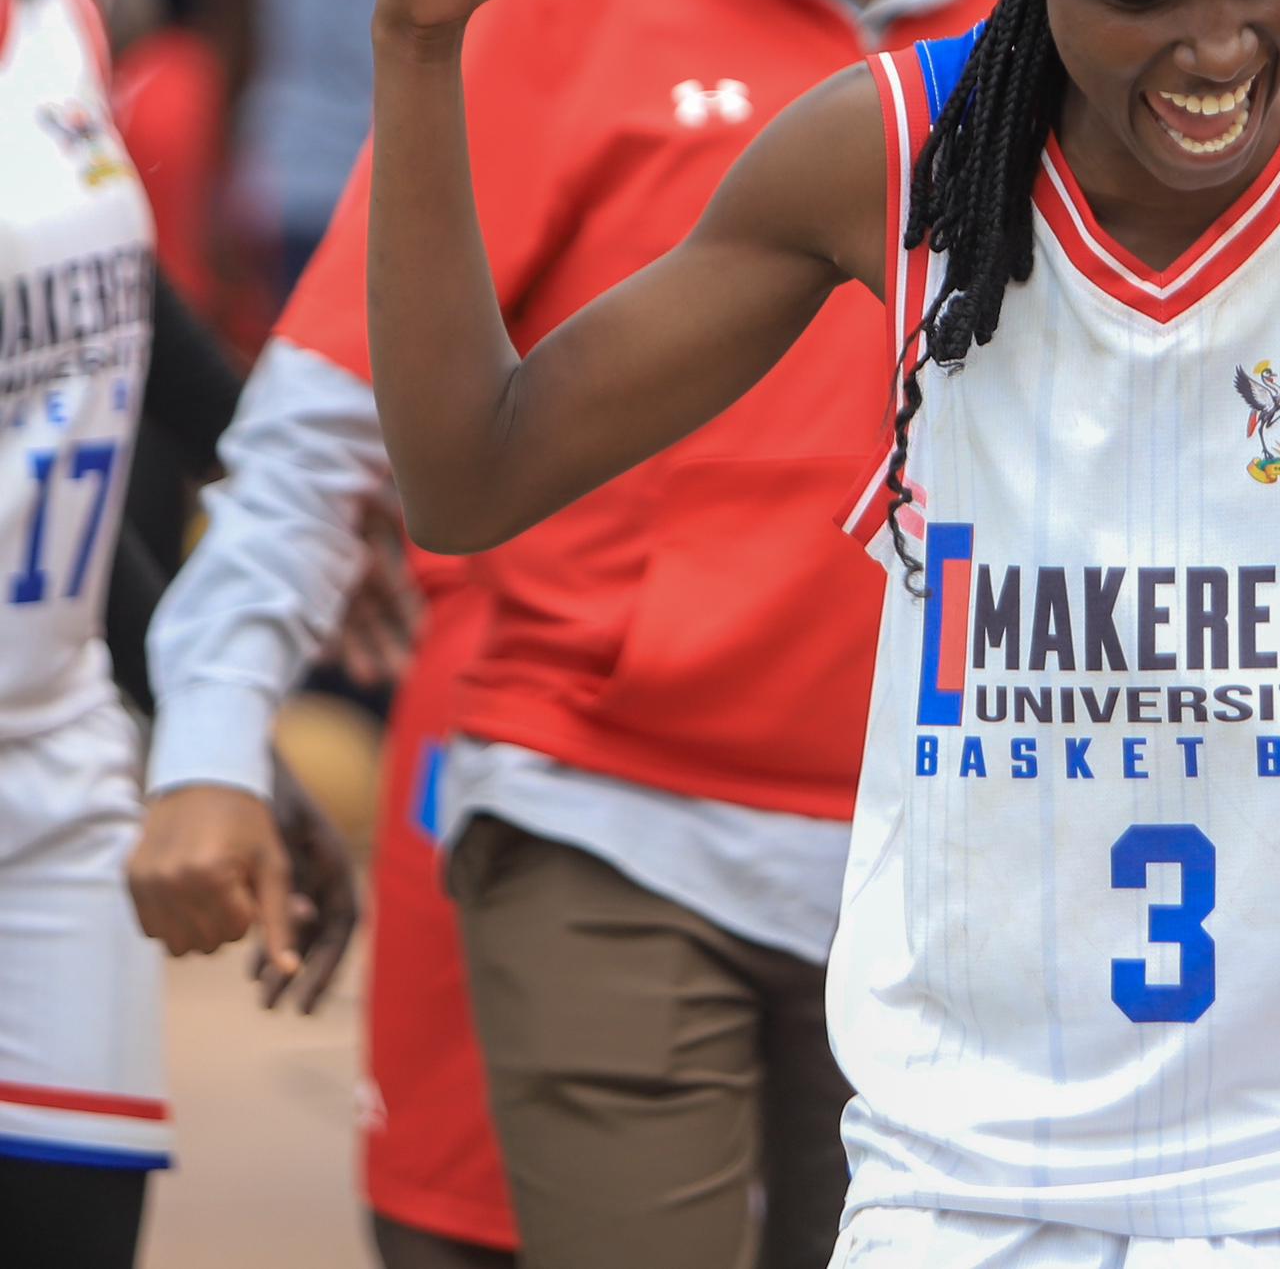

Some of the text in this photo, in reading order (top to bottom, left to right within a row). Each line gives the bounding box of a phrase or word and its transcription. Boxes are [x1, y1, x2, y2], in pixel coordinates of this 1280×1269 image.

[10, 444, 117, 603] 17
[915, 735, 1204, 779] BASKET
[1110, 823, 1217, 1023] 3
